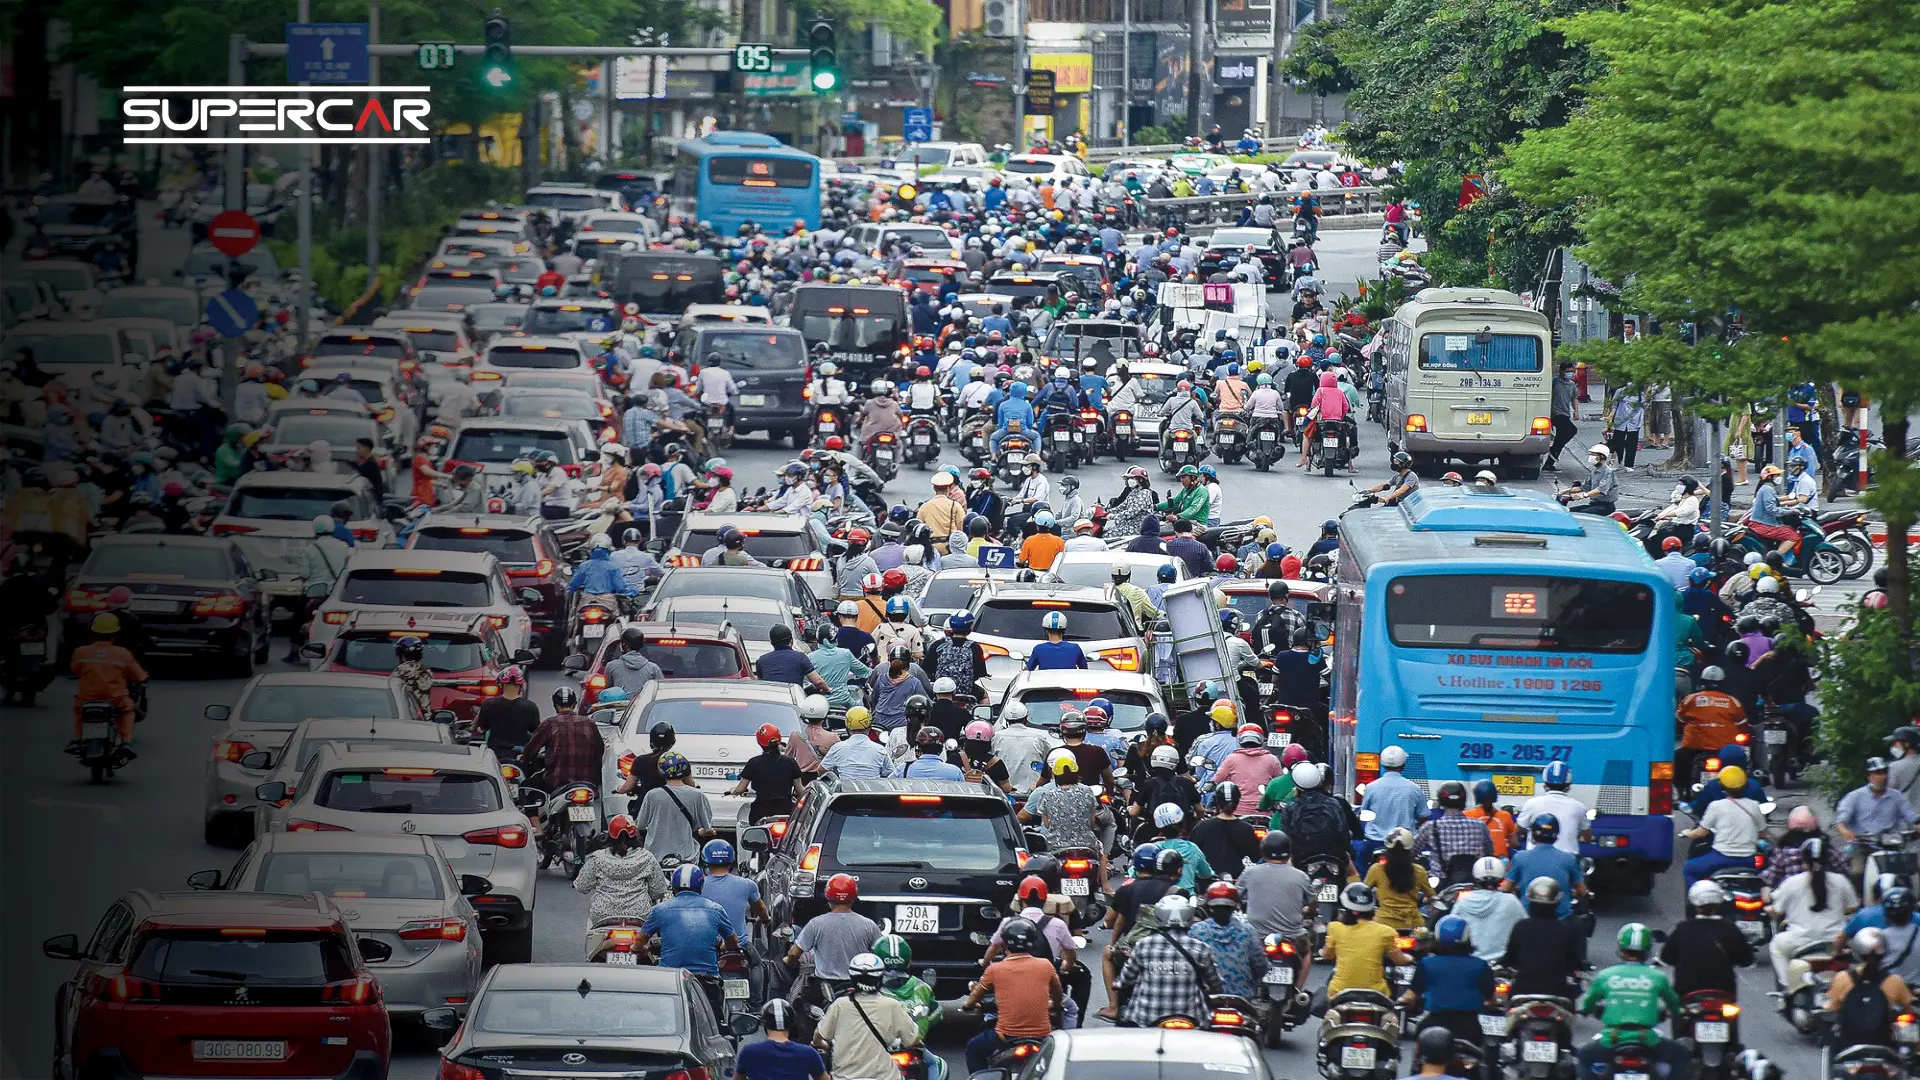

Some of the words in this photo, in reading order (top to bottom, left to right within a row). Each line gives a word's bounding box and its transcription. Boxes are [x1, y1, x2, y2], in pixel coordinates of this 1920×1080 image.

[420, 44, 454, 68] 07
[737, 46, 770, 70] 05
[1460, 378, 1473, 387] 29B
[1470, 654, 1493, 665] BUS
[1513, 677, 1555, 691] 1900
[1561, 679, 1603, 692] 1296
[1460, 742, 1494, 760] 29B
[1512, 744, 1573, 762] 205.27
[1504, 776, 1522, 784] 29B
[1497, 785, 1530, 794] 205.27
[906, 906, 928, 919] 30A
[897, 919, 937, 932] 774.67
[884, 957, 904, 965] Grab
[1608, 975, 1653, 989] Grab
[206, 1043, 282, 1058] 30G-080.99
